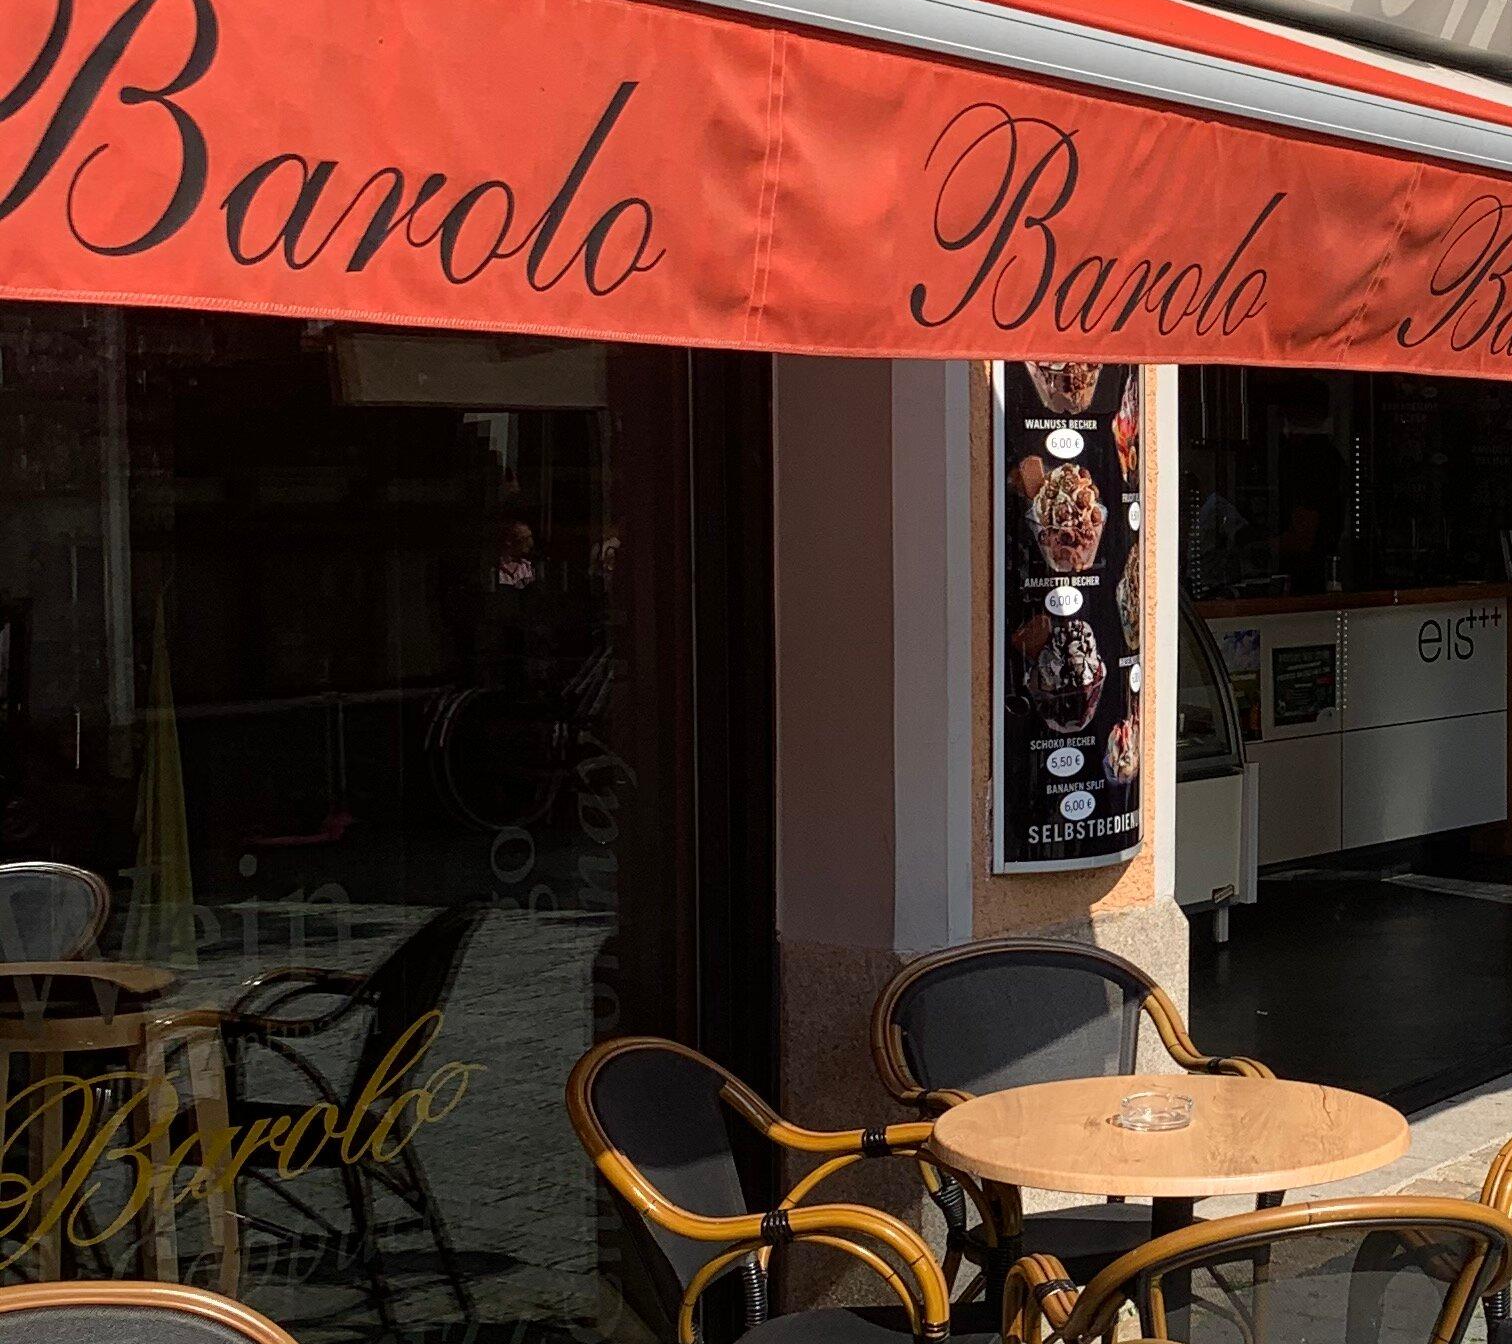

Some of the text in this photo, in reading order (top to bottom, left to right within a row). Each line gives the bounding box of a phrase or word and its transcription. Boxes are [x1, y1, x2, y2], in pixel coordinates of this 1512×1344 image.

[911, 102, 1287, 337] Barolo
[1025, 419, 1098, 430] WALNUSS BECHER
[1051, 437, 1072, 450] 6,00
[1024, 576, 1100, 588] AMARETTO BECHER
[1049, 594, 1079, 608] 6,00 €
[1030, 736, 1096, 751] SCHOKO BECHER
[1051, 755, 1081, 769] 5,50 €
[1046, 779, 1105, 795] BANANEN SPLIT
[1064, 797, 1092, 813] 6,00 €
[0, 1009, 487, 1270] Barolo
